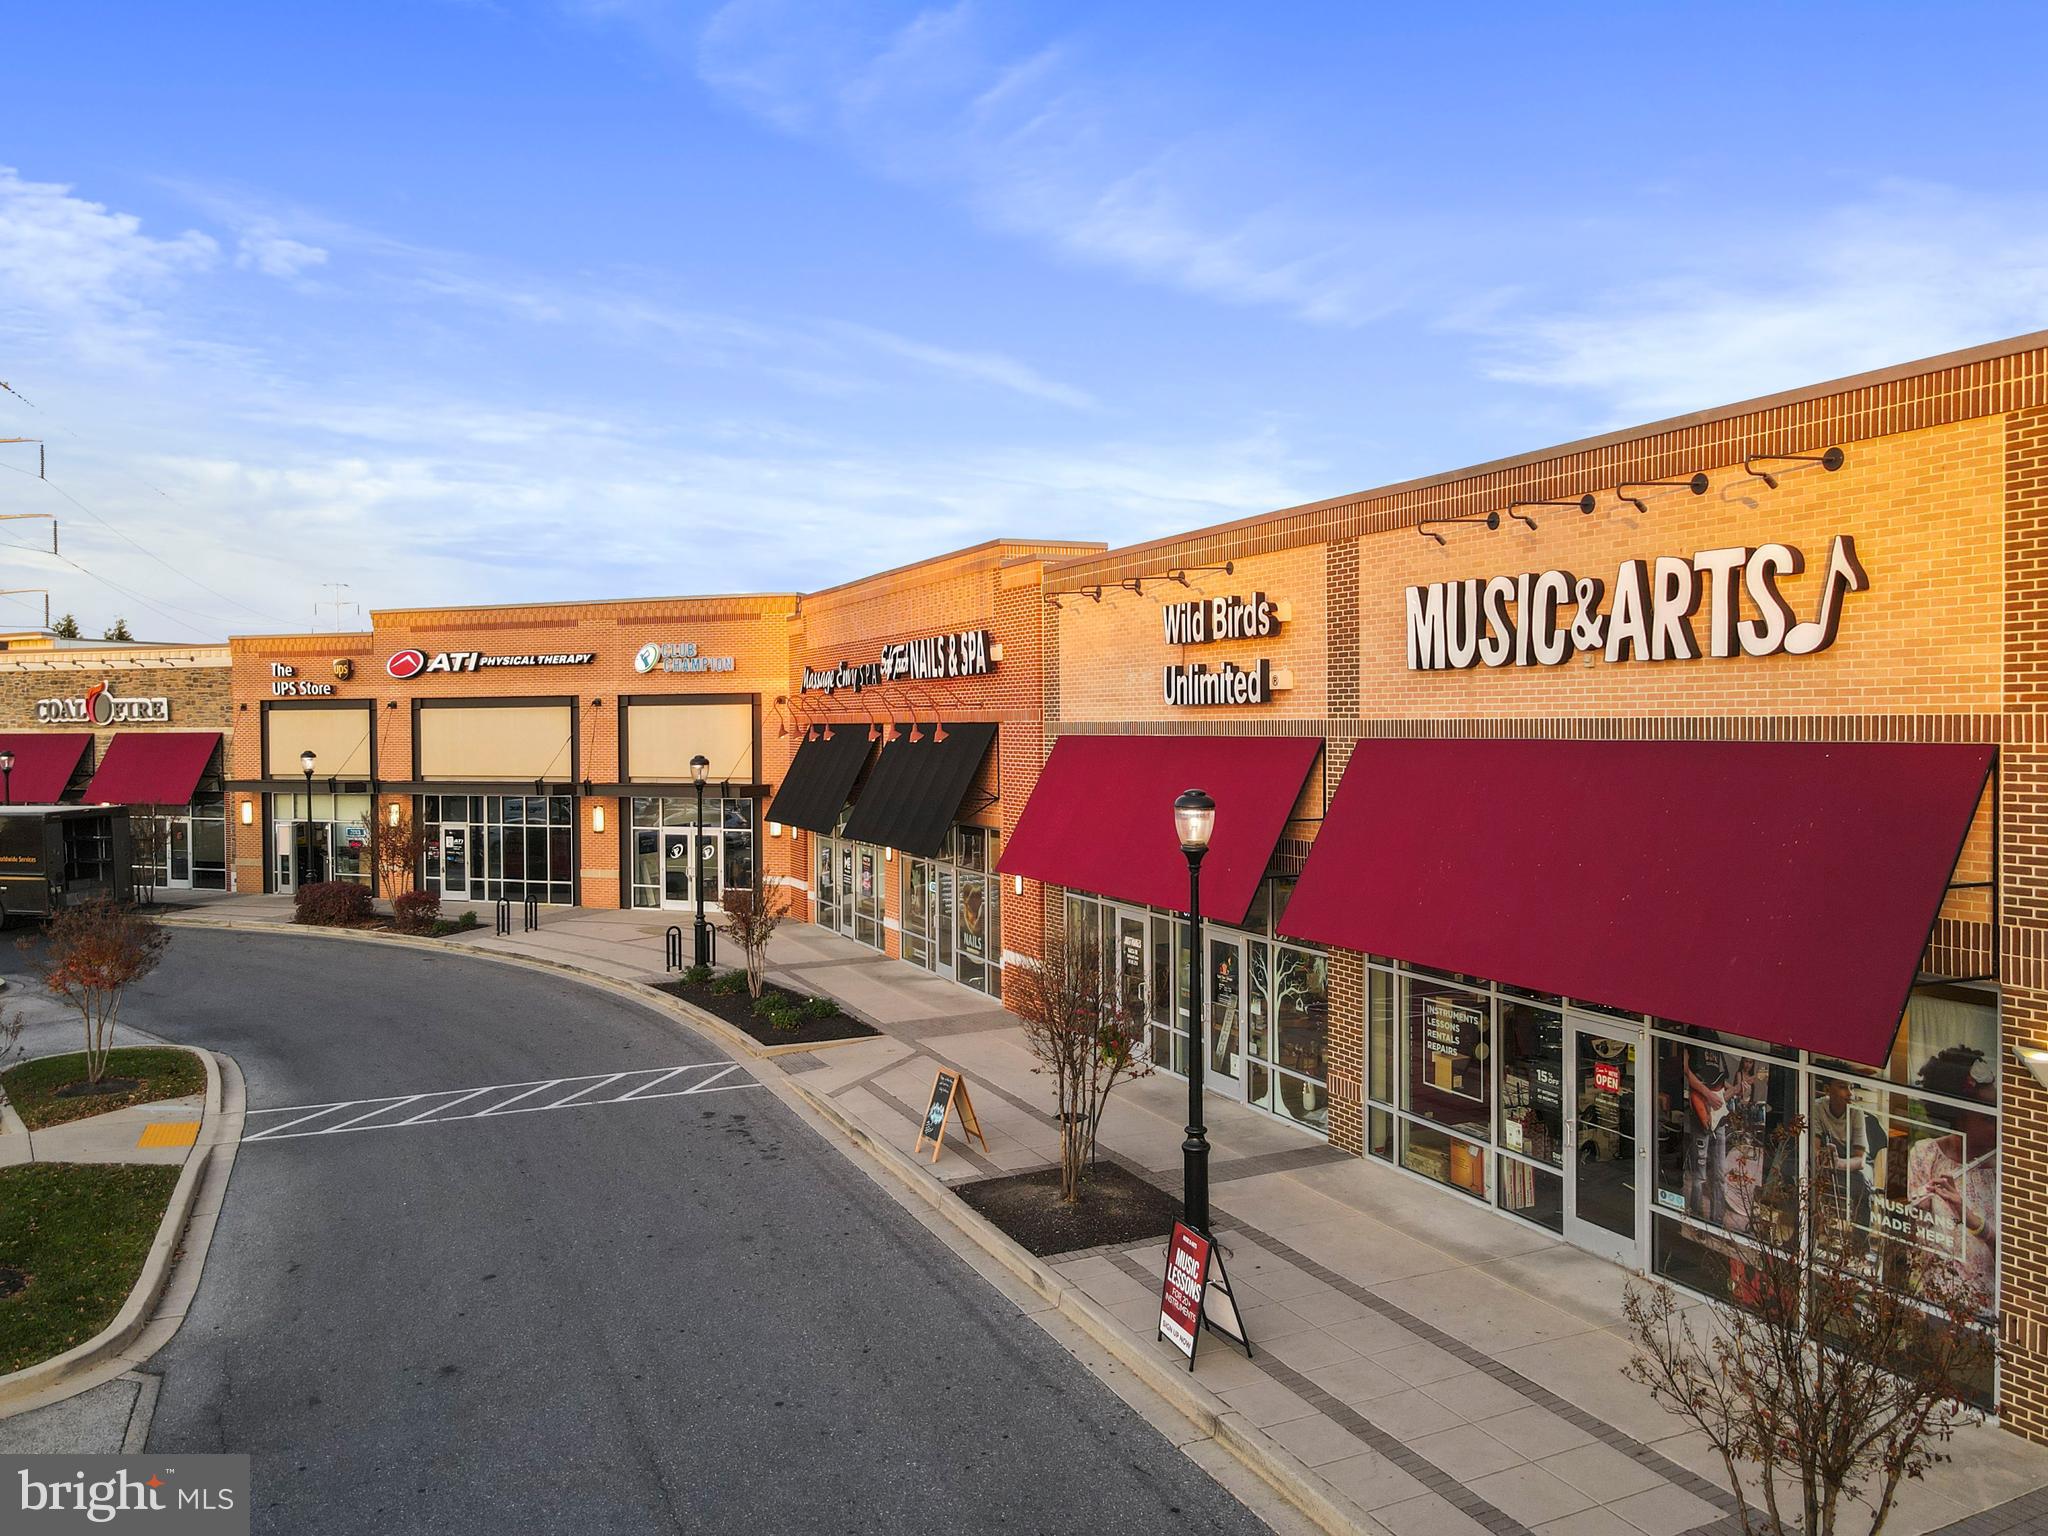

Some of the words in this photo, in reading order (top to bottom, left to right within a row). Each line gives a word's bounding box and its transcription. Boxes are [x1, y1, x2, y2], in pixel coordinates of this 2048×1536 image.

[1162, 599, 1205, 645] Wild
[1212, 591, 1270, 640] Birds
[662, 643, 698, 657] CLUB
[910, 635, 945, 679] NAILS
[948, 633, 959, 677] &
[961, 631, 986, 676] SPA
[271, 662, 293, 677] The
[426, 652, 479, 671] ATI
[480, 655, 536, 666] PHYSICAL
[538, 654, 592, 665] THERAPY
[663, 656, 735, 672] CHAMPION
[334, 664, 348, 678] ups
[800, 666, 835, 694] Massage
[836, 661, 858, 692] Envy
[272, 681, 297, 696] UPS
[299, 680, 331, 695] Store
[1163, 658, 1262, 705] Unlimited
[35, 699, 89, 721] COAL
[112, 699, 167, 721] FIRE
[963, 932, 982, 950] NAILS
[1427, 1004, 1479, 1025] INSTRUMENTS
[1427, 1017, 1460, 1033] LESSONS
[1427, 1029, 1460, 1045] RENTALS
[1427, 1041, 1458, 1056] REPAIRS
[1547, 1078, 1560, 1086] OFF
[1596, 1073, 1619, 1090] OPEN
[1869, 1193, 1955, 1231] MUSICIANS
[1175, 1247, 1200, 1280] MUSIC
[1168, 1262, 1202, 1303] LESSONS
[1172, 1287, 1183, 1302] FOR
[1165, 1292, 1197, 1323] INSTRUMENTS
[1162, 1319, 1173, 1334] SIGN
[1173, 1328, 1180, 1338] UP
[1179, 1335, 1192, 1350] NOW
